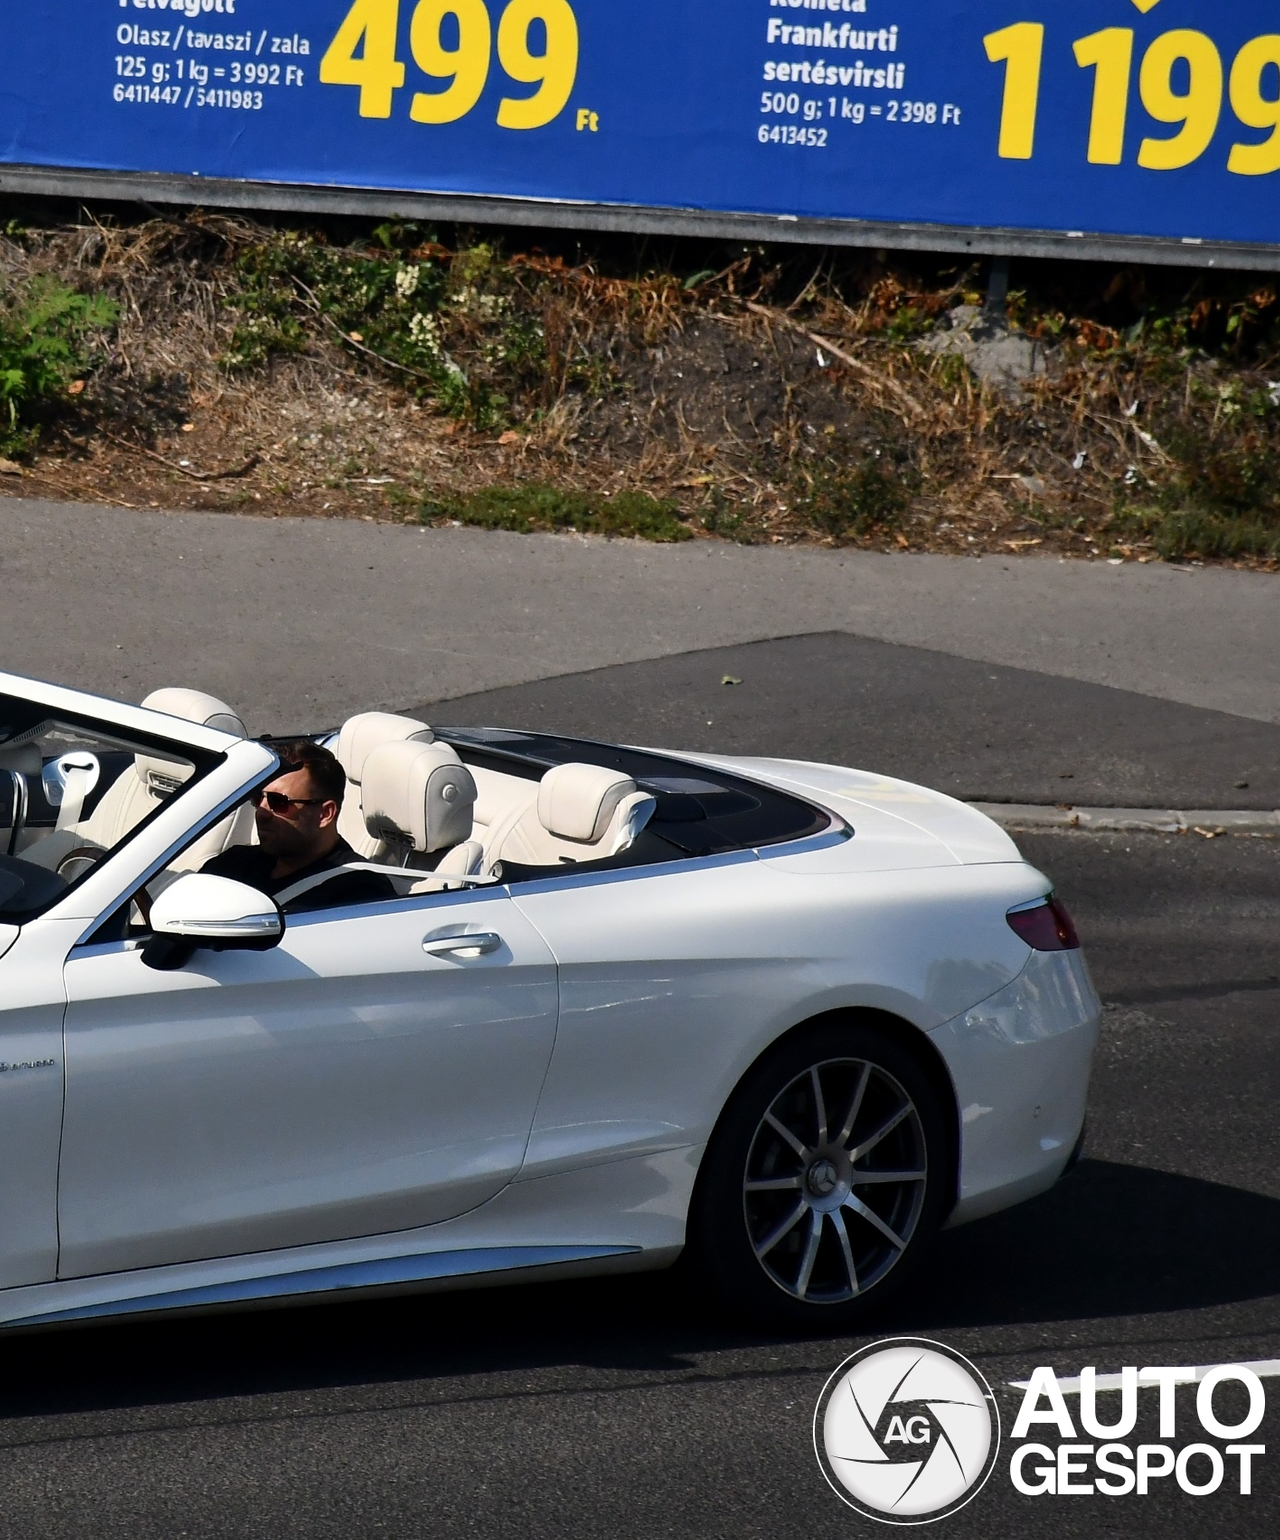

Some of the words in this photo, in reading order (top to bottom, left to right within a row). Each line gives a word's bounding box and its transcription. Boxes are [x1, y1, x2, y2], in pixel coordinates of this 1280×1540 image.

[116, 23, 171, 47] Olasz
[186, 29, 252, 51] tavaszi
[270, 33, 310, 55] zala
[766, 17, 899, 52] Frankfurti
[114, 55, 146, 78] 125
[151, 62, 171, 84] g;
[175, 59, 184, 79] 1
[189, 59, 209, 86] kg
[285, 65, 304, 87] Ft
[319, 0, 579, 130] 499
[575, 108, 599, 132] Ft
[763, 59, 906, 90] sertésvirsli
[113, 83, 182, 105] 6411447
[760, 92, 800, 115] 500
[803, 100, 822, 121] g;
[828, 97, 837, 117] 1
[841, 97, 865, 124] kg
[941, 103, 961, 126] Ft
[757, 124, 828, 147] 6413452
